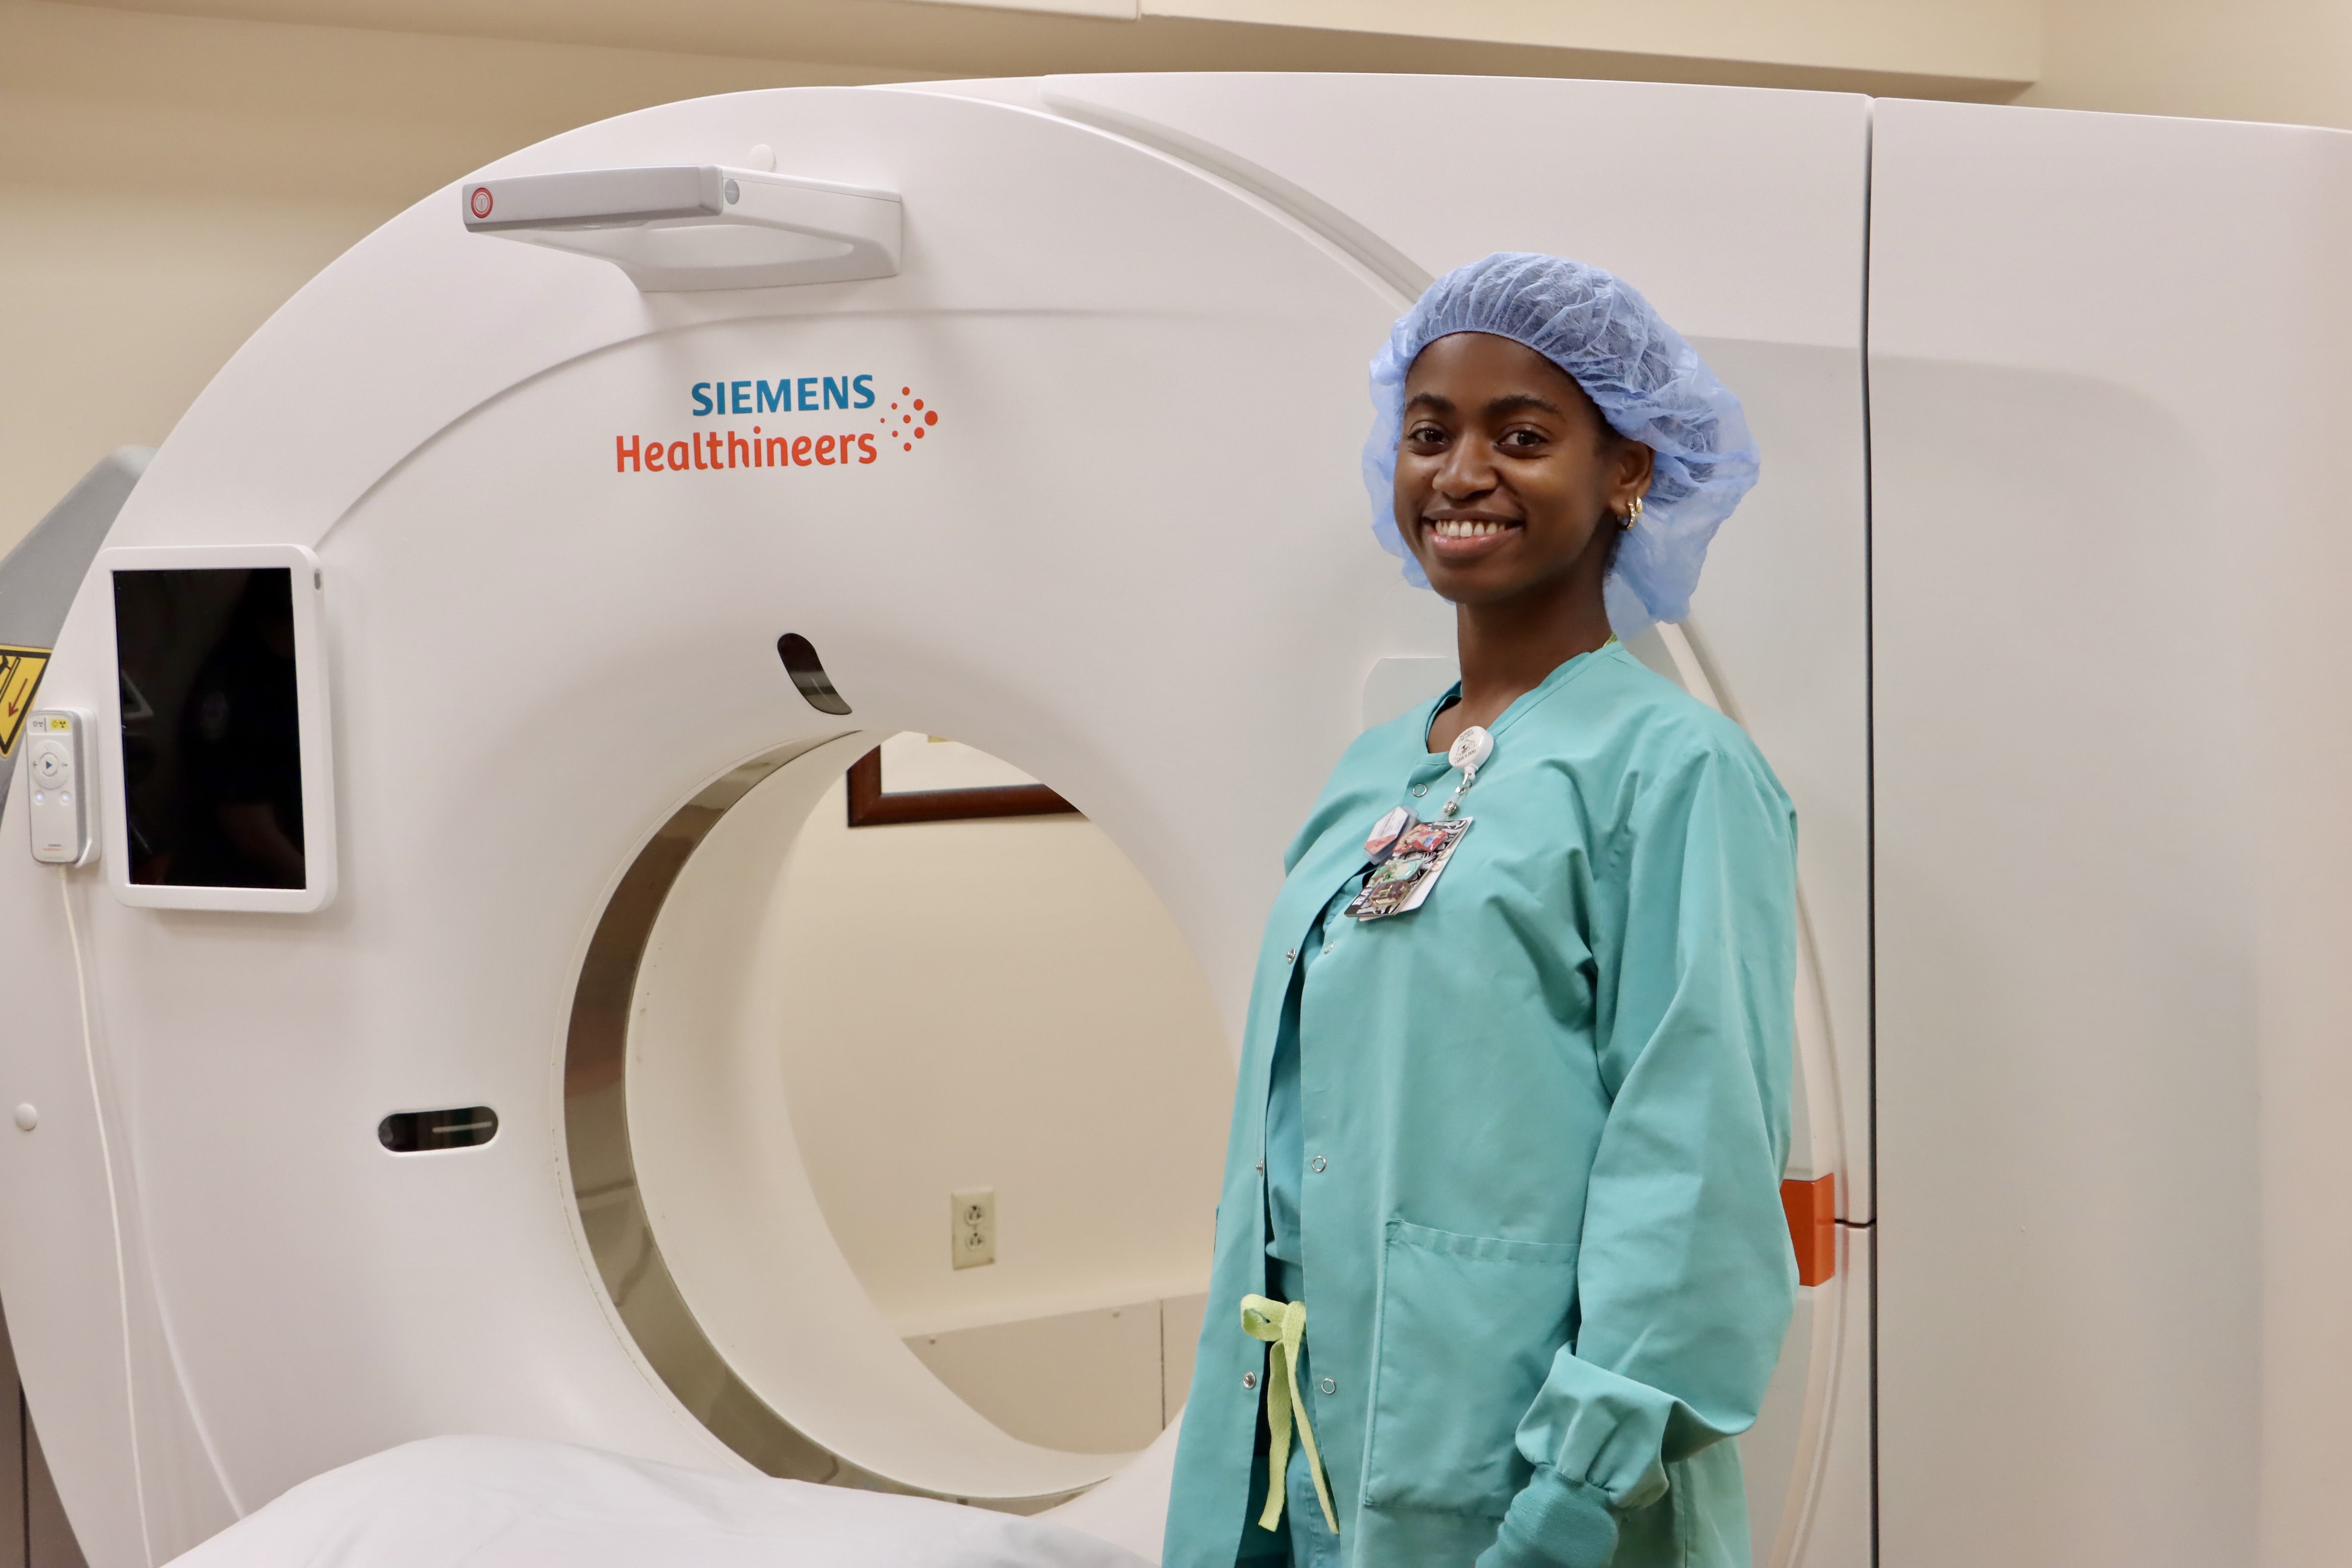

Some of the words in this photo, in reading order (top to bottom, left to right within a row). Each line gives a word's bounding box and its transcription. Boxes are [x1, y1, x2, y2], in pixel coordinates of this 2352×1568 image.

[691, 374, 875, 416] SIEMENS
[616, 425, 877, 472] Healthineers
[1468, 748, 1476, 757] DOG
